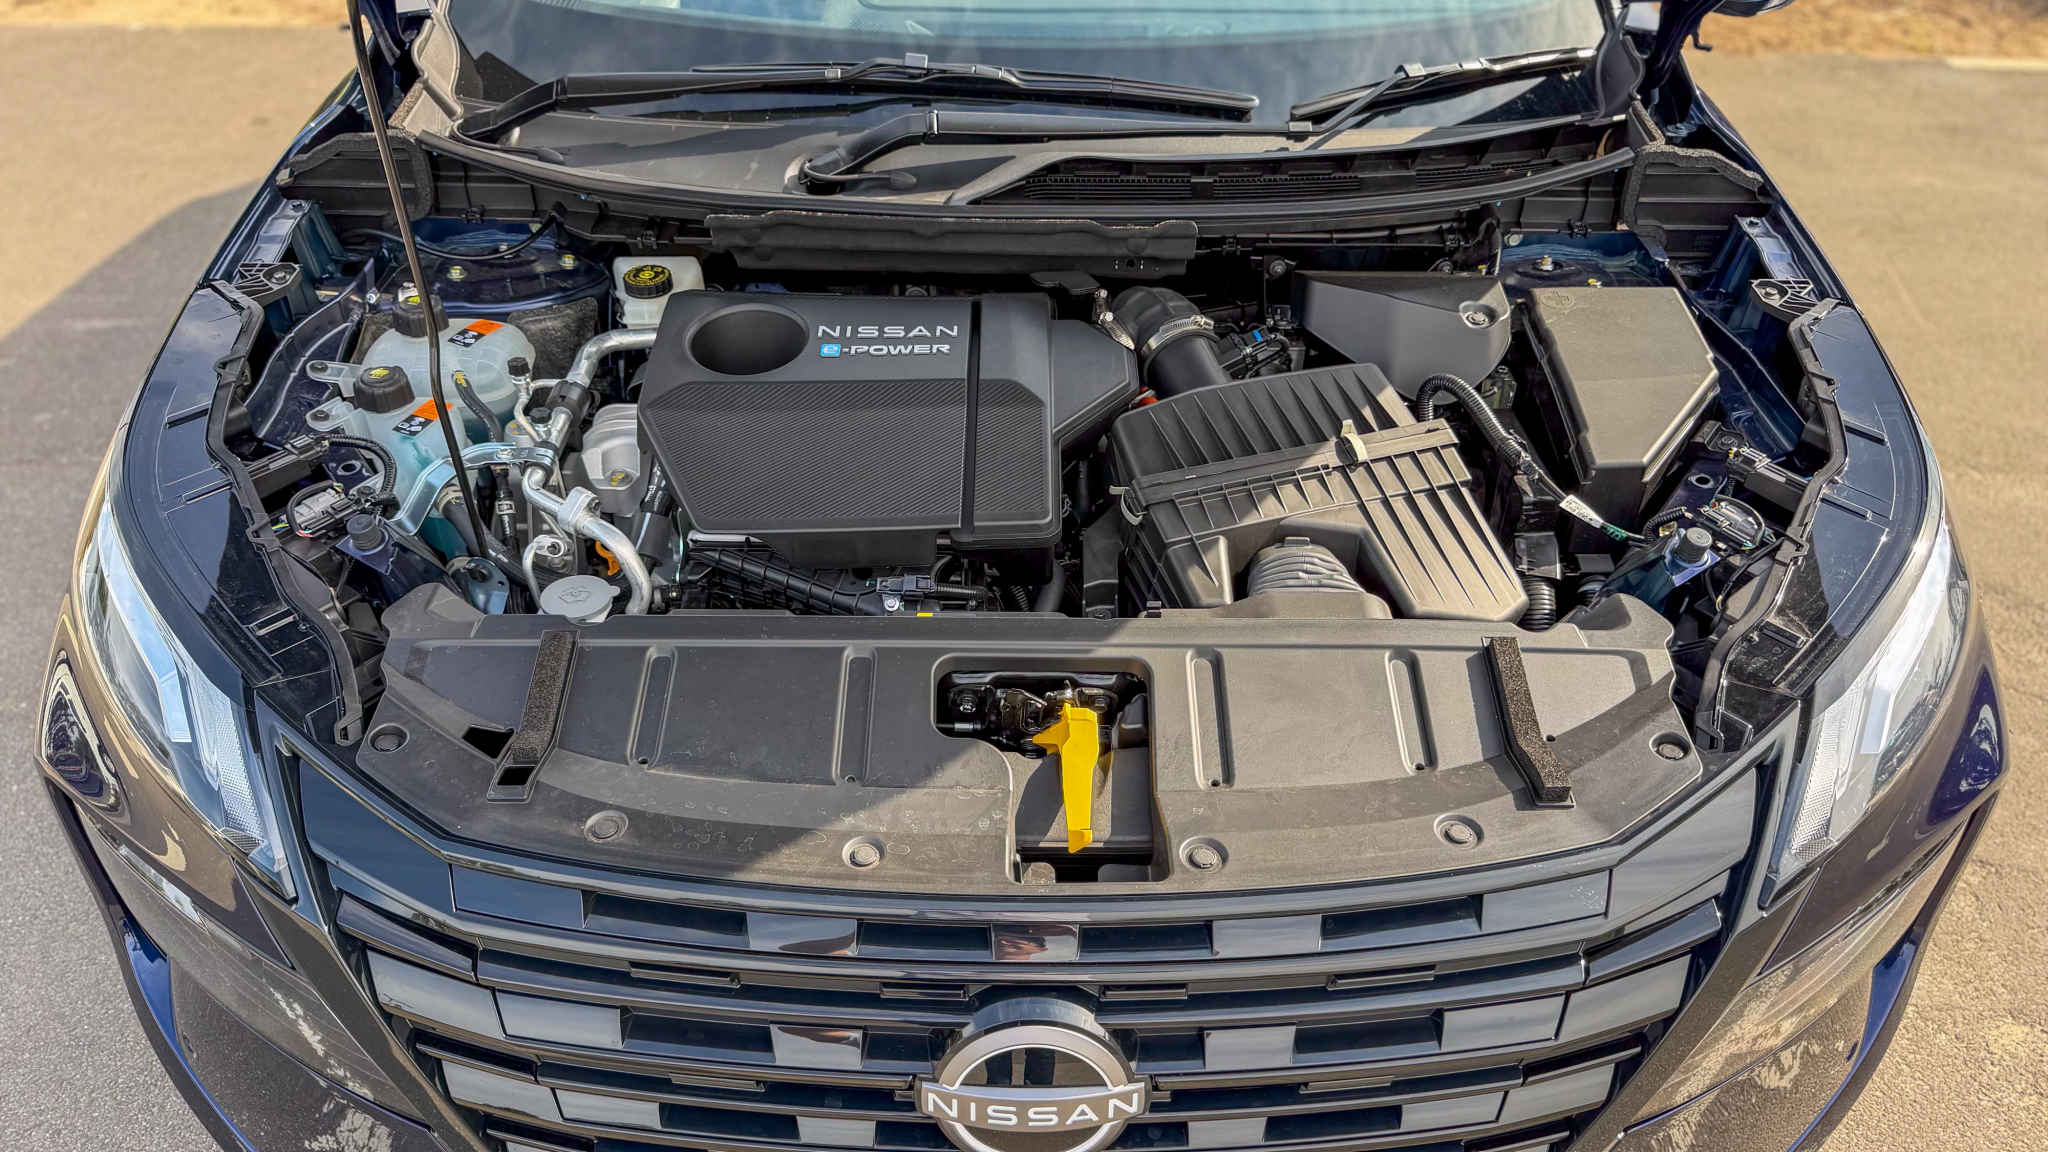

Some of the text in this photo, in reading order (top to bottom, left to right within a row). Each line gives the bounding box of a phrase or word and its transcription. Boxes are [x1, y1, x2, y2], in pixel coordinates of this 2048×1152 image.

[817, 325, 958, 339] NISSAN
[820, 343, 951, 358] e-POWER
[927, 1092, 1139, 1127] NISSAN
